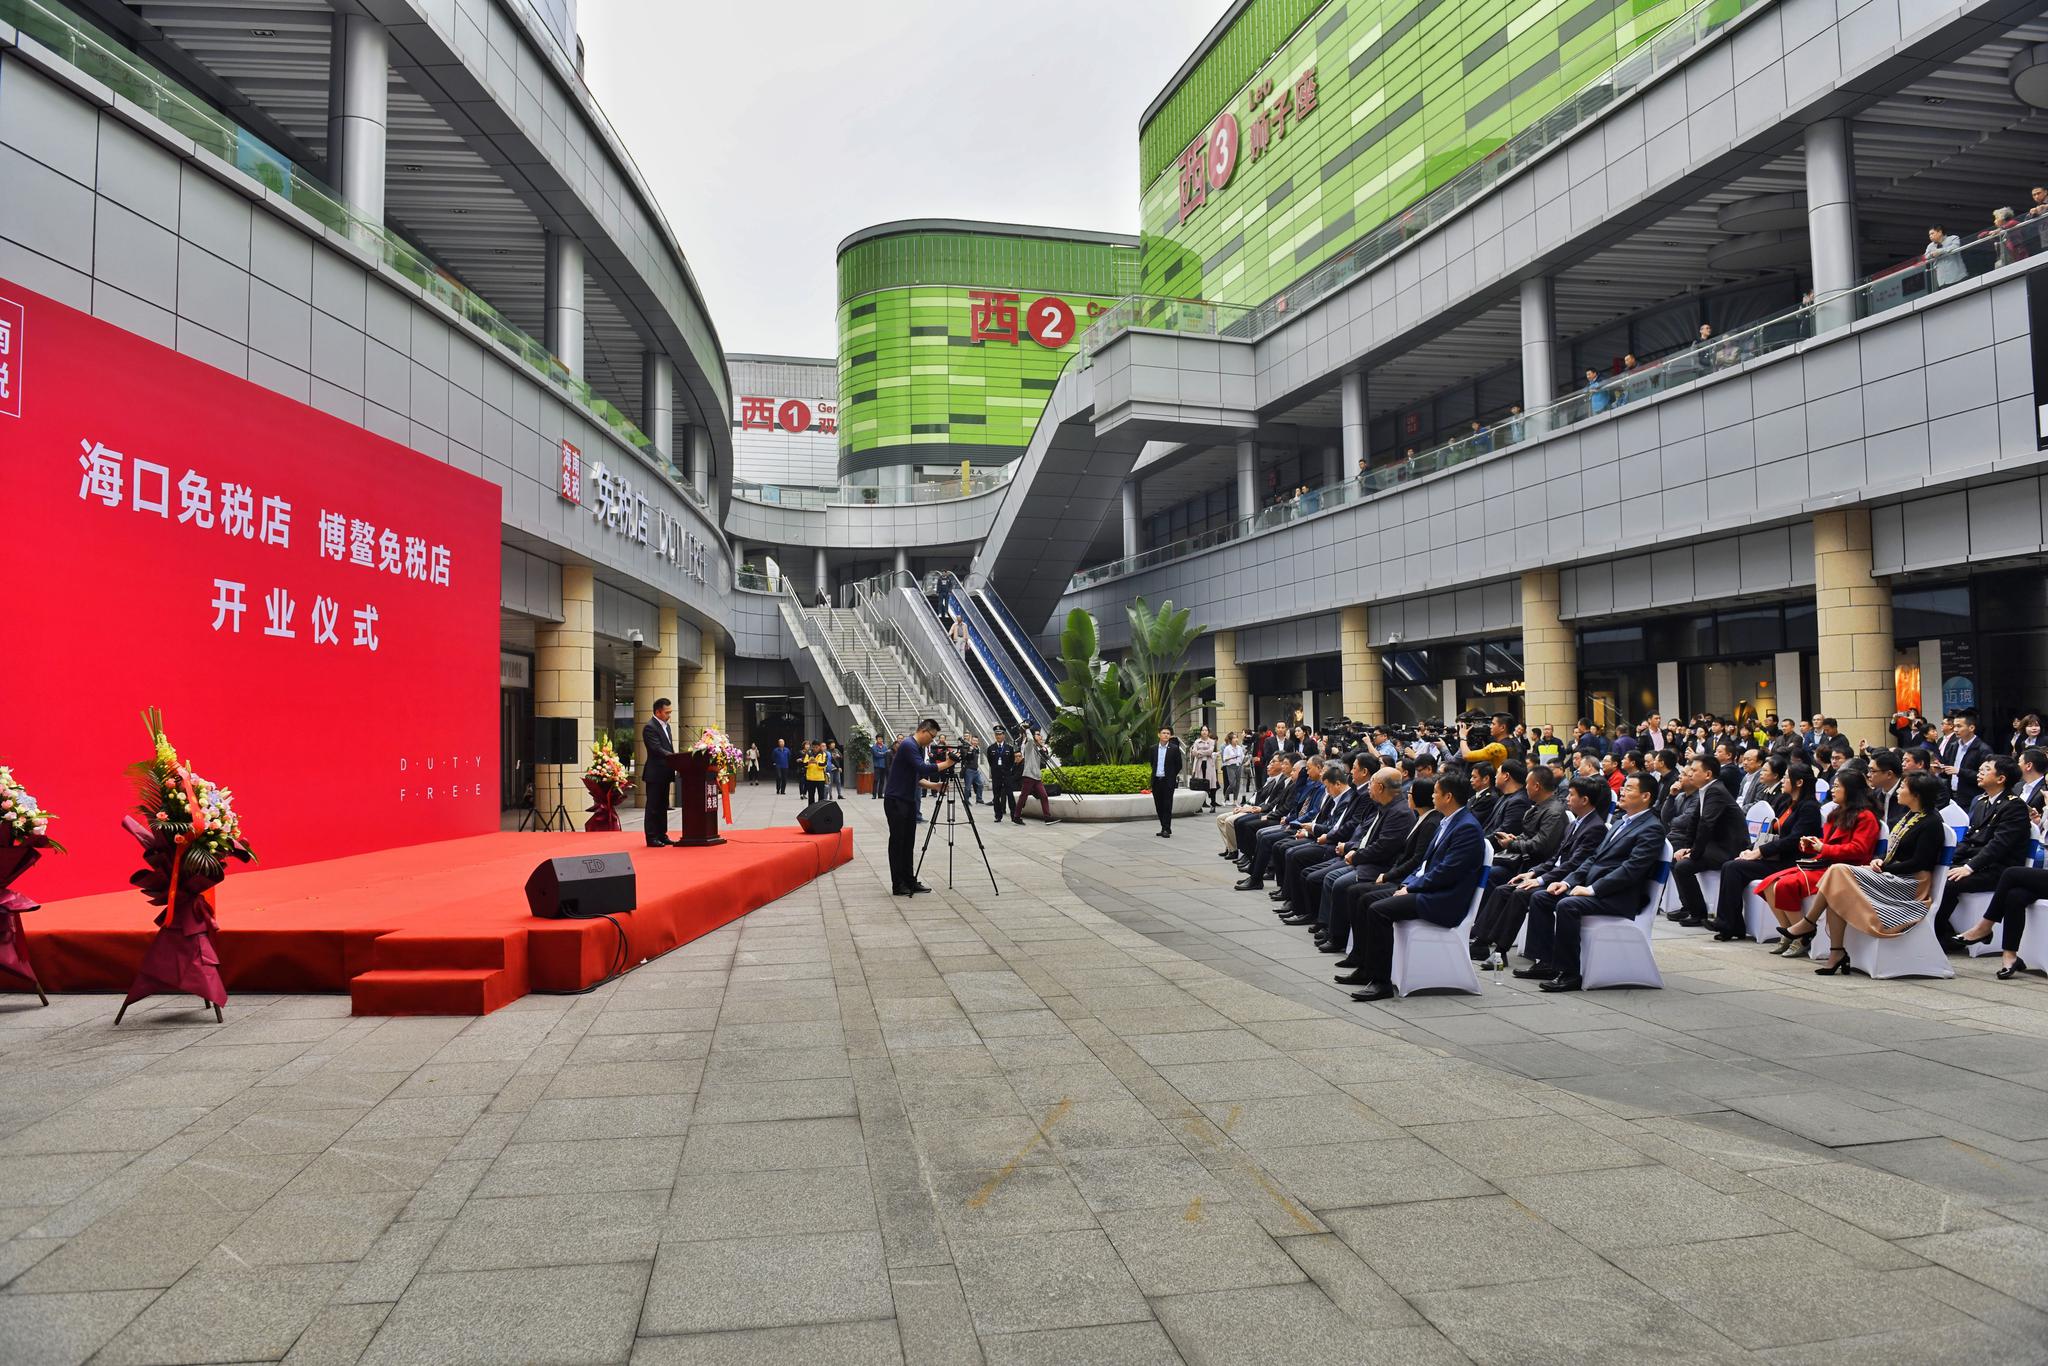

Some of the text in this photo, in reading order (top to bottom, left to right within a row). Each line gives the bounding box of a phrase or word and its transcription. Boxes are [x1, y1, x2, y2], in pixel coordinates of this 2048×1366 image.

[1248, 78, 1273, 112] Leo
[1250, 66, 1319, 163] 狮子座
[79, 438, 451, 587] 海口免税店 博鳌免税店
[592, 461, 648, 546] 免税店
[212, 578, 379, 651] 开业仪式
